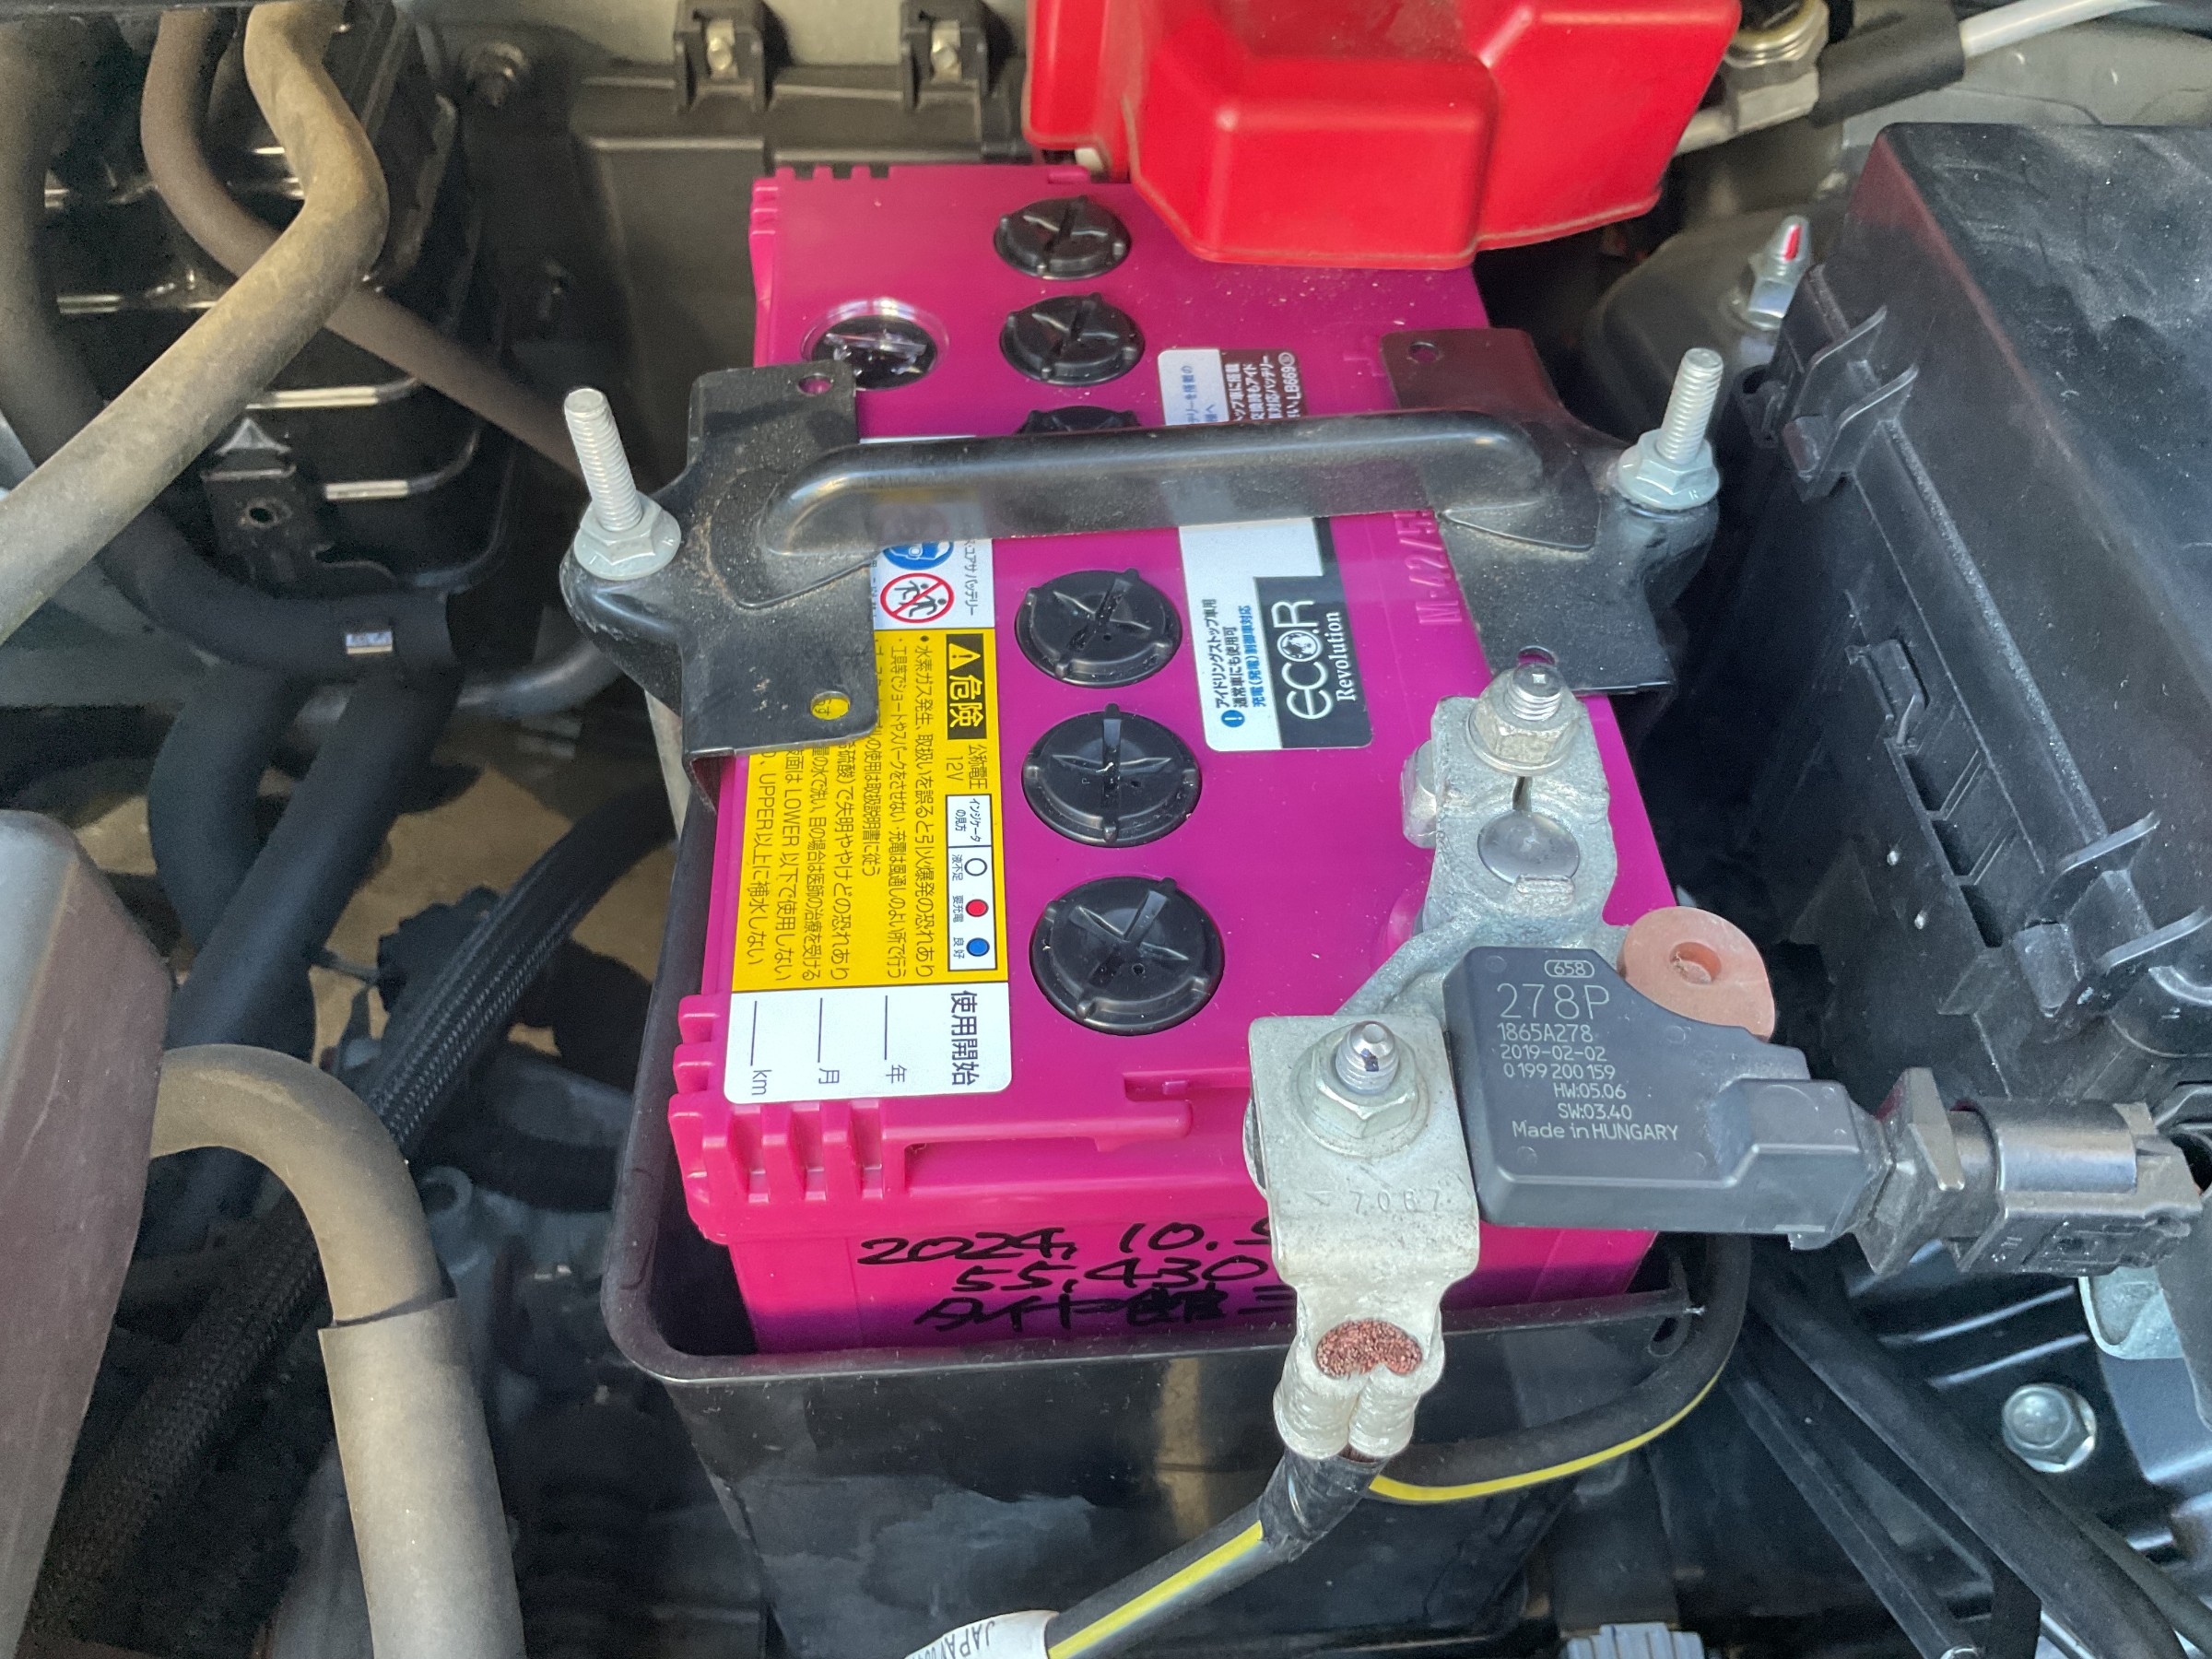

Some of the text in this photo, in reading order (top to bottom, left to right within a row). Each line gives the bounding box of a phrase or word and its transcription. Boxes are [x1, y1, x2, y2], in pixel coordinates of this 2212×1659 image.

[1201, 599, 1230, 709] アイドリングストップ車用
[1324, 612, 1357, 702] Revolution
[948, 674, 984, 728] 危険
[946, 756, 964, 782] 12V
[967, 743, 988, 790] 公称電圧
[782, 788, 802, 847] LOWER
[954, 809, 967, 832] の見方
[969, 798, 983, 843] インジケータ
[951, 853, 964, 881] 液不足
[952, 894, 964, 924] 要充電
[1553, 960, 1587, 976] 658
[1497, 982, 1610, 1020] 278P
[950, 990, 980, 1086] 使用開始
[1497, 1022, 1594, 1042] 1865A278
[1500, 1043, 1607, 1062] 2019-02-02
[751, 1068, 772, 1096] km
[818, 1067, 841, 1085] 月
[886, 1064, 908, 1084] 年
[1553, 1082, 1628, 1100] HW:05.06
[1558, 1102, 1633, 1121] SW:03.40
[1512, 1120, 1678, 1141] Made in HUNGARY
